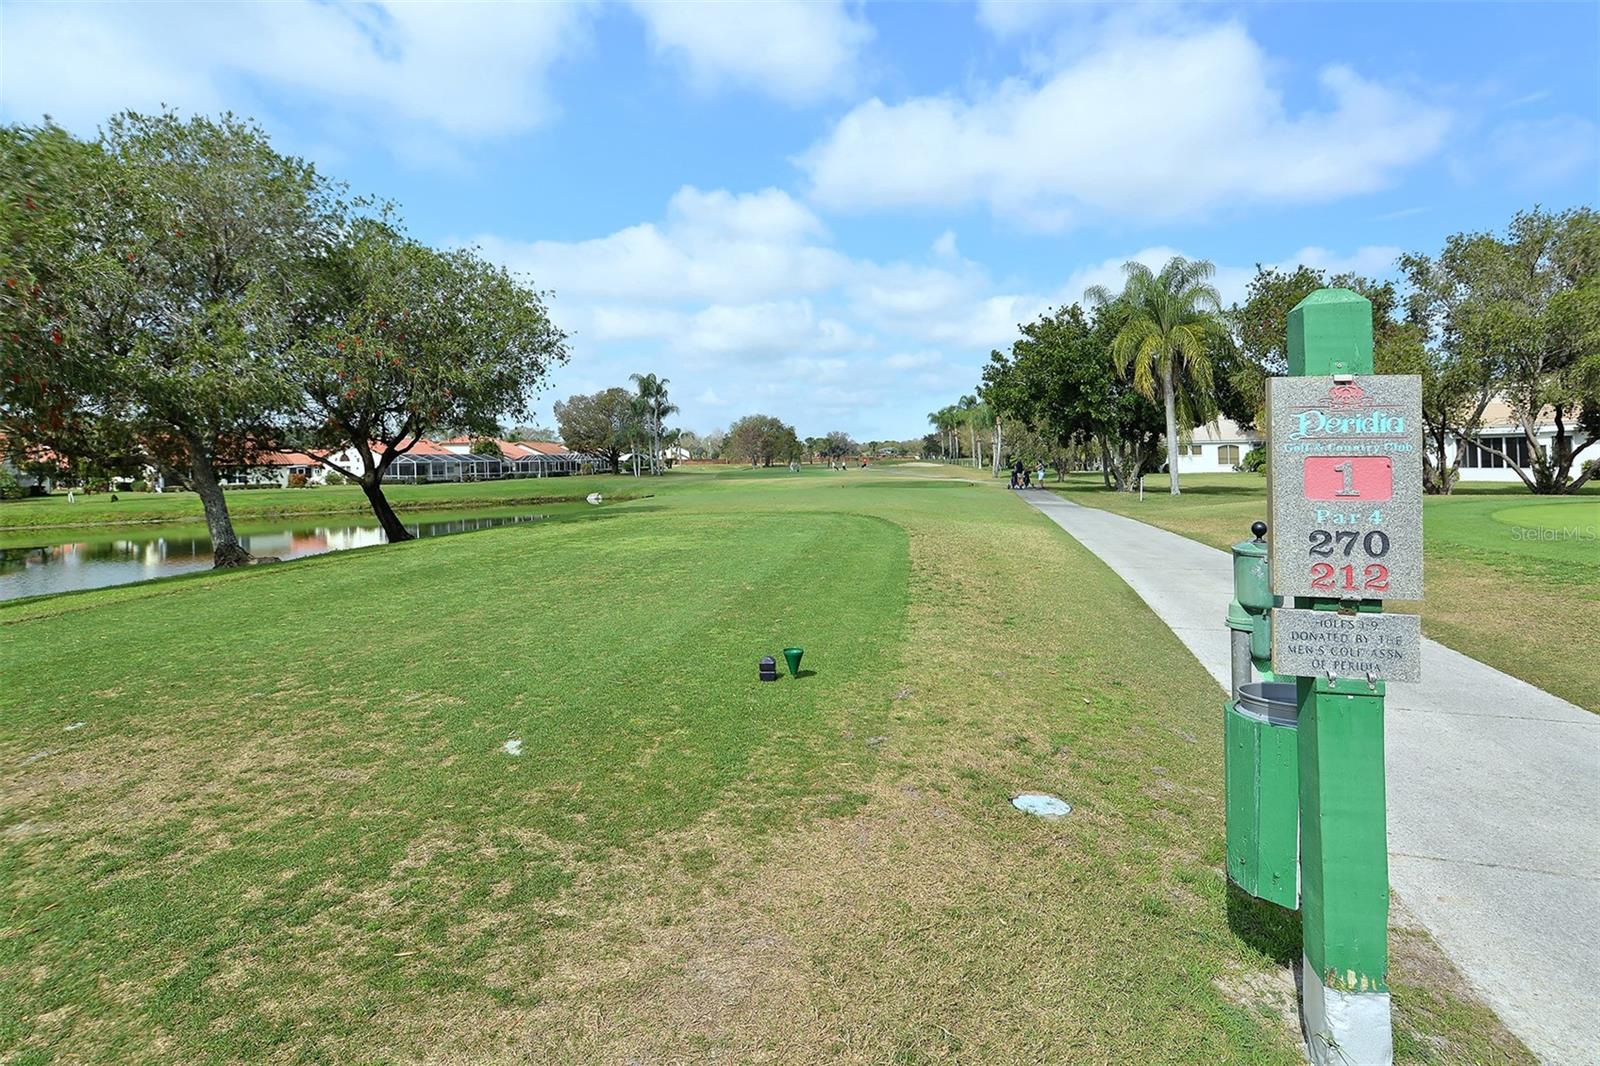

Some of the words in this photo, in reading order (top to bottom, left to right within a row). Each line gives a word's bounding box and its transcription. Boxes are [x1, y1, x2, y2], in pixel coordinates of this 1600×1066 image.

[1290, 410, 1404, 440] Peridia
[1326, 443, 1380, 453] Country
[1384, 442, 1413, 453] Club
[1334, 461, 1359, 496] 1
[1315, 509, 1359, 523] Par
[1369, 509, 1383, 524] 4
[1309, 530, 1390, 558] 270
[1311, 563, 1390, 592] 212
[1291, 631, 1349, 644] DONATED
[1355, 634, 1369, 645] BY
[1333, 660, 1381, 673] PERIDIA
